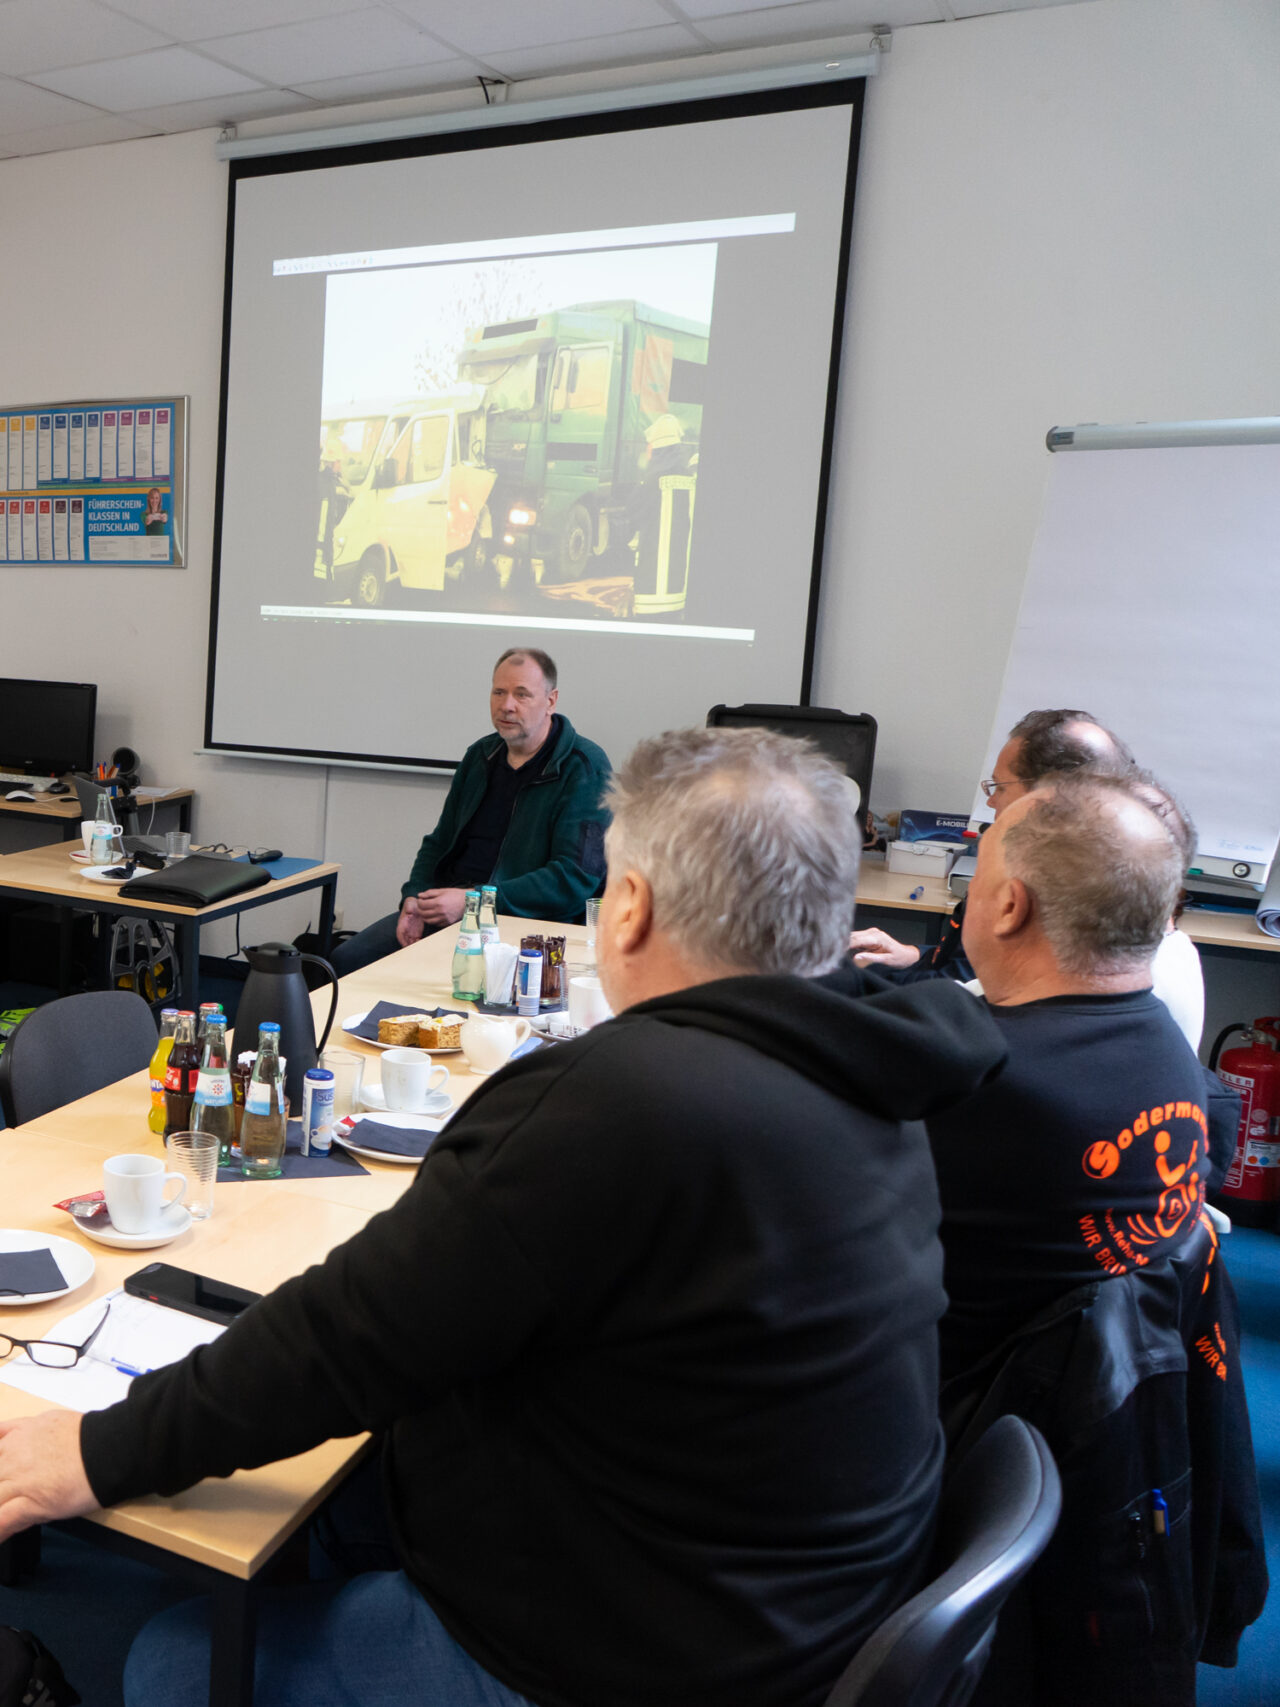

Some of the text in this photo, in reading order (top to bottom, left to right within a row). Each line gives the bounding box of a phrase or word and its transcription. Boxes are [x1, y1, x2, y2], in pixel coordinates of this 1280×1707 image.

[88, 499, 144, 509] FÜHRERSCHEIN-
[88, 512, 130, 520] KLASSEN IN
[88, 523, 139, 532] DEUTSCHLAND
[1078, 1213, 1102, 1248] WIR
[1195, 1335, 1221, 1369] WIR
